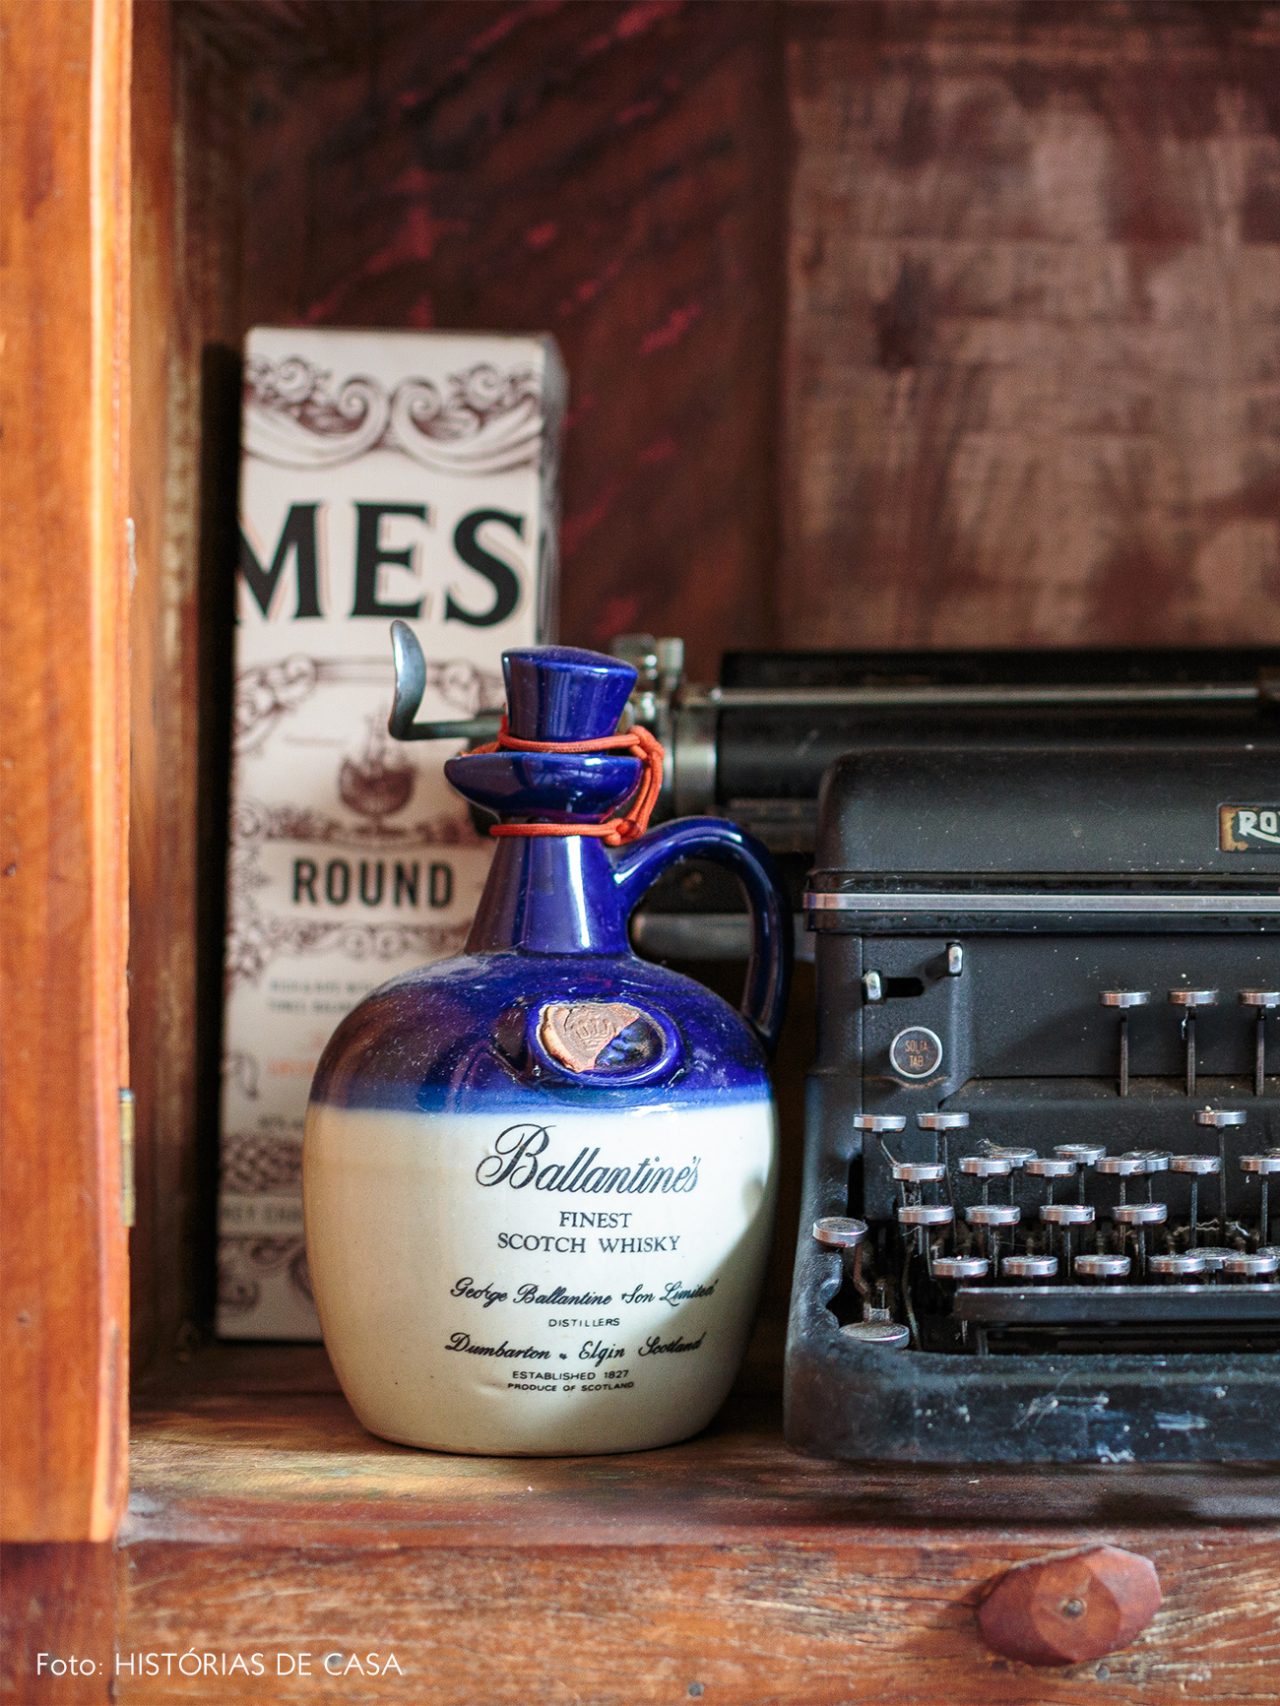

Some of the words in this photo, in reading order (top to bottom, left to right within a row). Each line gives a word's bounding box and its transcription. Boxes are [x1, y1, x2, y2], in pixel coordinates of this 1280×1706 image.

[291, 859, 454, 909] ROUND
[475, 1123, 701, 1194] Ballantine's
[560, 1211, 632, 1229] FINEST
[497, 1233, 586, 1253] SCOTCH
[599, 1235, 680, 1253] WHISKY
[450, 1277, 508, 1308] George
[513, 1283, 613, 1305] Ballantine
[659, 1279, 719, 1307] Limited
[548, 1318, 620, 1328] DISTILLERS
[445, 1332, 552, 1360] Dumbarton
[578, 1340, 625, 1367] Elgin
[638, 1331, 707, 1357] Scotland
[512, 1370, 597, 1380] ESTABLISHED
[604, 1369, 630, 1379] 1827
[507, 1383, 557, 1392] PRODUCE
[562, 1384, 576, 1392] OF
[581, 1381, 635, 1392] SCOTLAND
